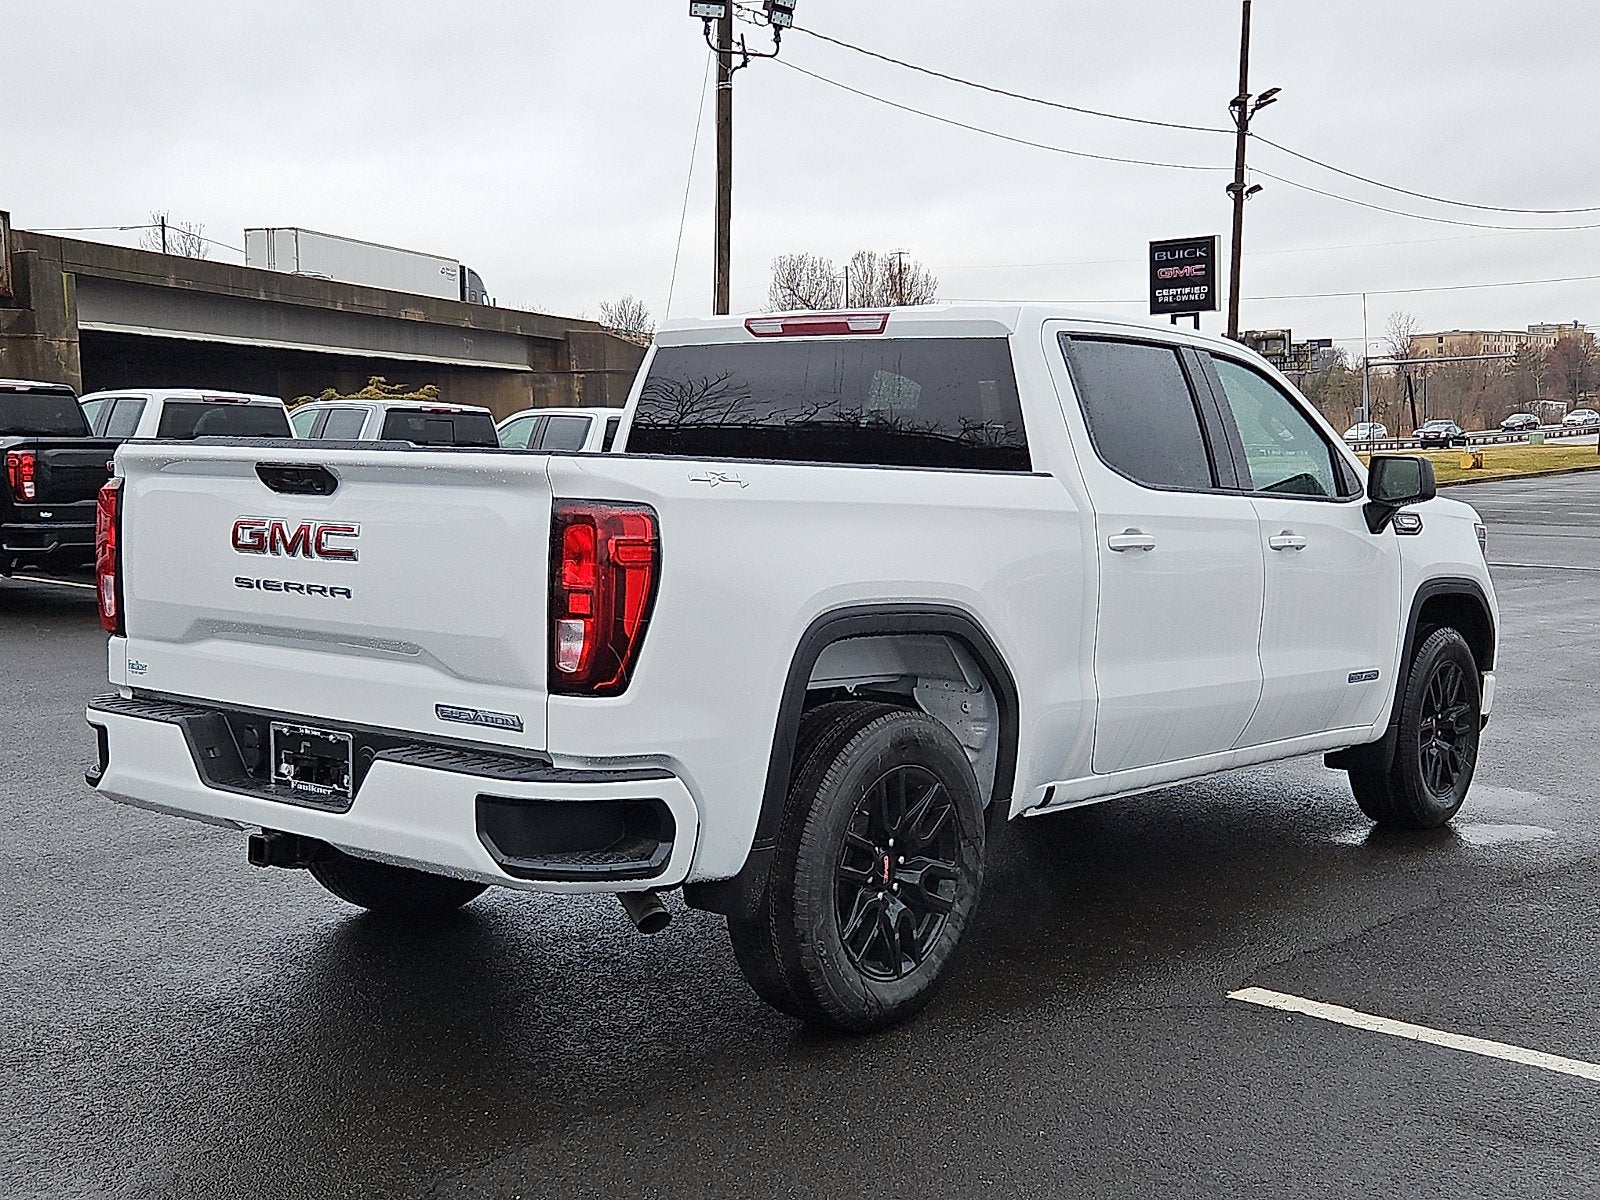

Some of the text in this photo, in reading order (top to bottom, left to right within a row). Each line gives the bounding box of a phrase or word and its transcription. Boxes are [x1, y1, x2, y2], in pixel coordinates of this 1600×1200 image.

[1155, 247, 1207, 261] BUICK
[1157, 264, 1206, 279] GMC
[1156, 286, 1208, 296] CERTIFIED
[1158, 293, 1205, 303] PRE-OWNED
[231, 515, 360, 562] GMC
[234, 576, 352, 599] SIERRA
[291, 781, 333, 795] Faulkner
